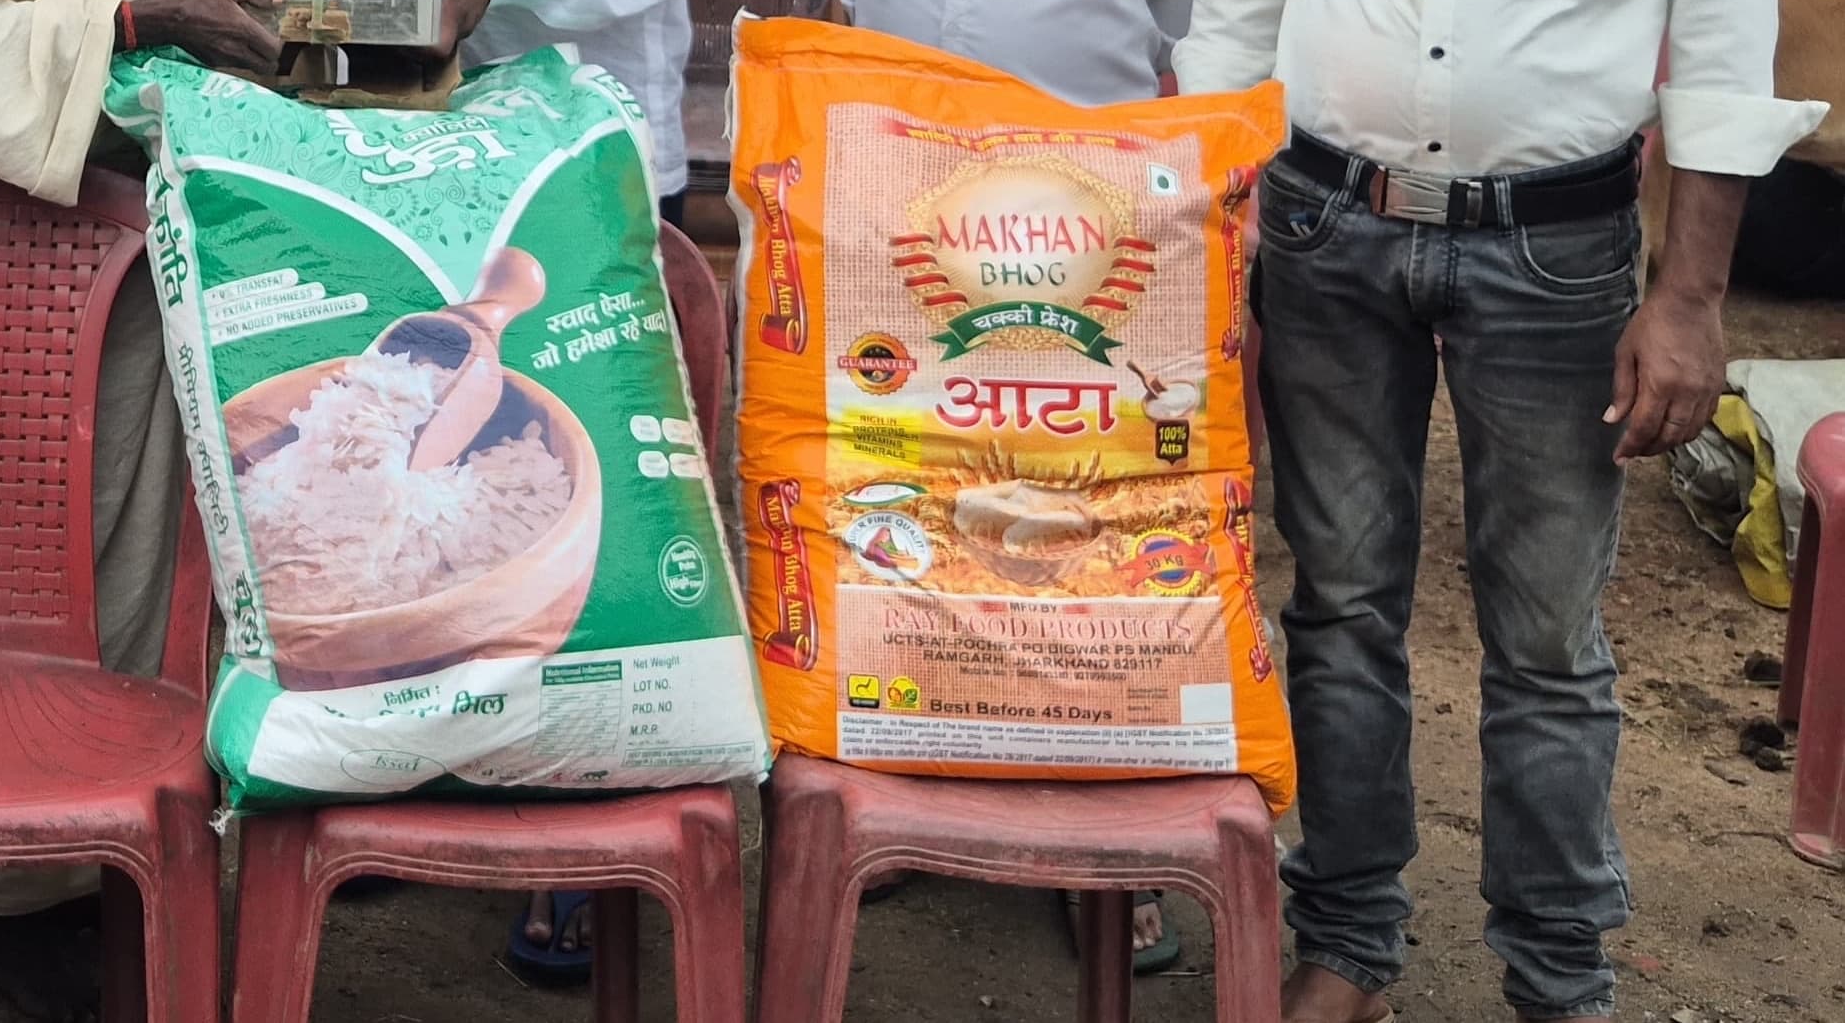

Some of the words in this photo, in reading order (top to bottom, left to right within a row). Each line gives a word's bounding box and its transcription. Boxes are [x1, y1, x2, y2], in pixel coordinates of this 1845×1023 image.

[936, 213, 1107, 254] MAKHAN
[771, 239, 787, 280] Bhog
[237, 274, 284, 294] TRANSFAT
[979, 262, 1067, 287] BHOG
[223, 303, 252, 317] EXTRA
[255, 288, 313, 309] FRESHNESS
[778, 284, 792, 318] Atta
[226, 324, 239, 336] NO
[242, 316, 274, 331] ADDED
[277, 299, 357, 323] PRESERVATIVES
[546, 302, 600, 334] स्वाद
[971, 303, 1033, 329] चक्की
[1040, 305, 1080, 334] फ्रेश
[530, 341, 561, 370] जो
[564, 327, 618, 363] हमेशा
[619, 313, 640, 342] रहे
[840, 359, 915, 371] GUARANTEE
[935, 376, 1117, 435] आटा
[1159, 427, 1187, 441] 100%
[854, 443, 906, 458] MINERALS
[1160, 443, 1182, 455] Atta
[1146, 558, 1161, 571] 30
[787, 596, 805, 633] Atta
[883, 608, 939, 631] RAY
[952, 612, 1027, 638] FOOD
[1039, 618, 1192, 639] PRODUCTS
[1022, 642, 1043, 654] PO
[1048, 644, 1111, 655] DIGWAR
[1114, 644, 1135, 654] PS
[633, 658, 648, 670] Net
[650, 655, 680, 670] Weight
[1013, 656, 1109, 669] JHARKHAND
[633, 681, 651, 692] LOT
[654, 680, 671, 691] NO.
[930, 699, 970, 714] Best
[976, 702, 1037, 718] Before
[1042, 705, 1063, 719] 45
[1068, 706, 1113, 722] Days
